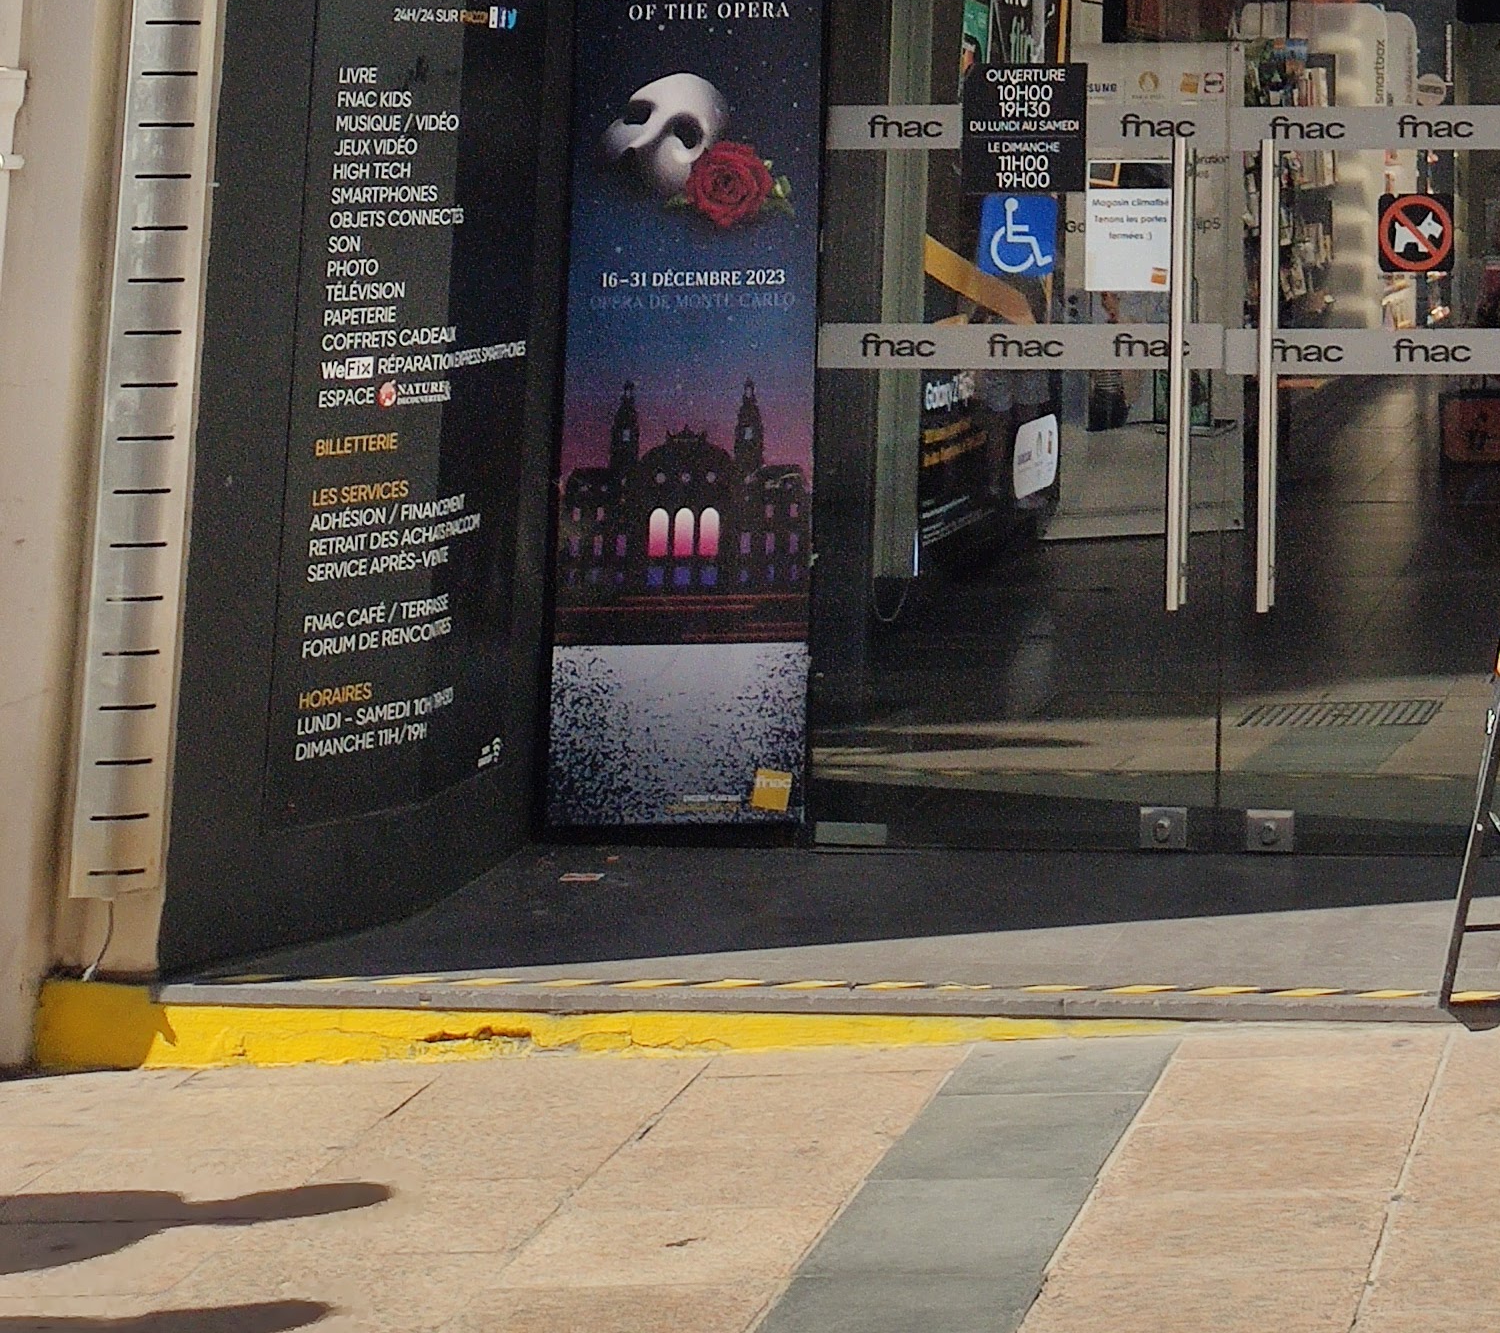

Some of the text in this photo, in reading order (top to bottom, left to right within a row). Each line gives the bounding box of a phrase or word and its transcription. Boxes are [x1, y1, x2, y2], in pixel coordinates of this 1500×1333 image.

[435, 8, 458, 23] SUR
[628, 1, 790, 21] OF THE OPERA
[339, 67, 377, 84] LIVRE
[986, 68, 1066, 83] OUVERTURE
[337, 90, 412, 108] FNAC KIDS
[997, 84, 1053, 102] 10H00
[999, 101, 1051, 118] 19H30
[335, 110, 459, 132] MUSIQUE VIDÉO
[868, 114, 943, 139] fnac
[970, 119, 1080, 132] DU LUNDI AU SAMEDI
[1120, 113, 1195, 138] fnac
[1269, 115, 1346, 139] fnac
[1397, 114, 1474, 138] fnac
[333, 134, 417, 156] JEUX VIDÉO
[988, 141, 1060, 153] LE DIMANCHE
[333, 162, 411, 180] HIGH TECH
[998, 155, 1049, 172] 11H00
[996, 172, 1050, 188] 19H00
[331, 186, 438, 205] SMARTPHONES
[1092, 198, 1129, 208] Magasin
[329, 209, 386, 229] OBJETS
[328, 235, 361, 254] SON
[326, 259, 379, 278] PHOTO
[602, 269, 786, 288] 16-31 DÉCEMBRE 2023
[325, 280, 405, 301] TÉLÉVISION
[323, 306, 397, 326] PAPETERIE
[322, 325, 457, 352] COFFRETS CADEAUX
[861, 333, 937, 357] fnac
[987, 333, 1064, 358] fnac
[1271, 338, 1344, 363] fnac
[1393, 338, 1472, 363] fnac
[321, 355, 374, 380] WeFix
[318, 387, 375, 408] ESPACE
[315, 432, 398, 457] BILLETTERIE
[312, 480, 409, 507] LES SERVICES
[310, 506, 386, 532] ADHÉSION
[309, 534, 367, 558] RETRAIT
[370, 529, 399, 550] DES
[307, 558, 367, 582] SERVICE
[304, 610, 344, 634] FNAC
[347, 601, 386, 627] CAFÉ
[302, 634, 356, 658] FORUM
[359, 632, 379, 651] DE
[299, 682, 372, 710] HORAIRES
[297, 699, 410, 736] LUNDI SAMEDI
[295, 722, 428, 761] DIMANCHE 11H/19H
